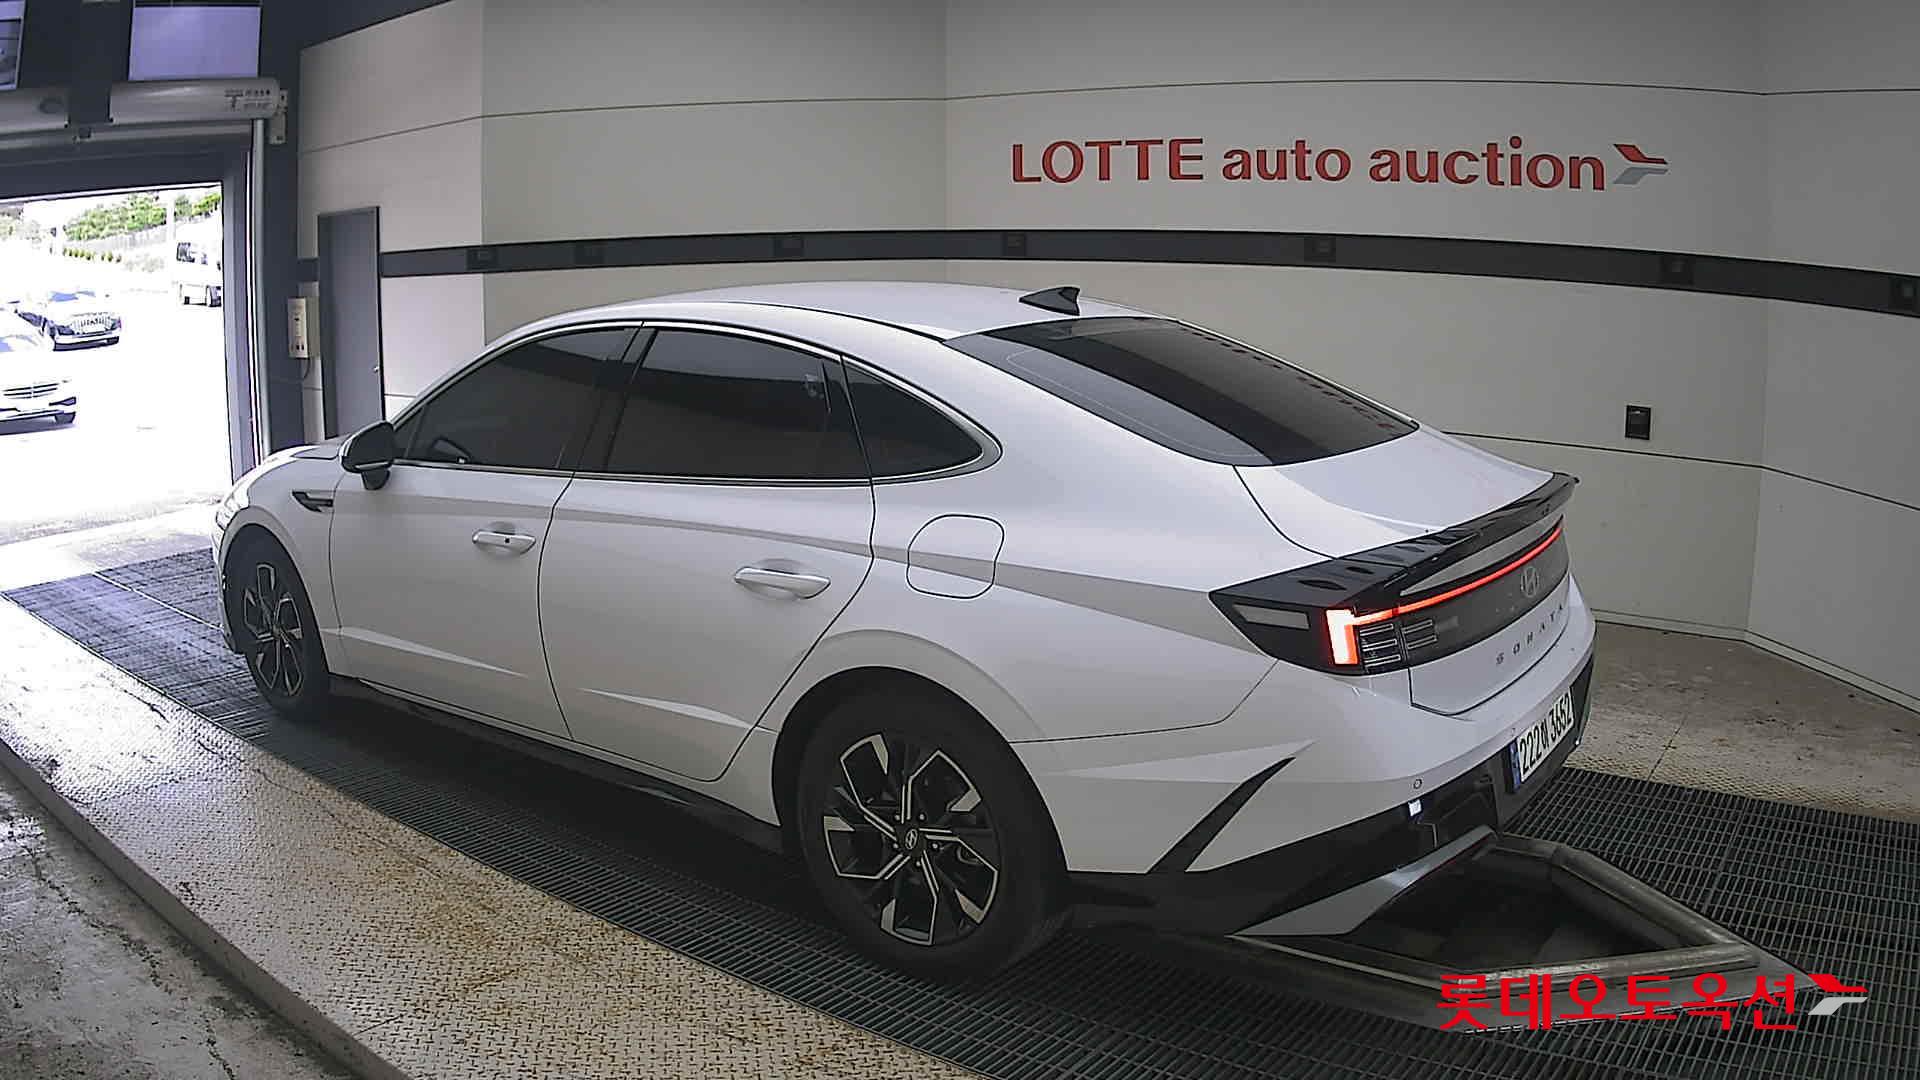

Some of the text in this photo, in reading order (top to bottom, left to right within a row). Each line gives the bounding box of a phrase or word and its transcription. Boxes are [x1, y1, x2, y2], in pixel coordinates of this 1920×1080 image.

[1012, 136, 1606, 190] LOTTE auto auction
